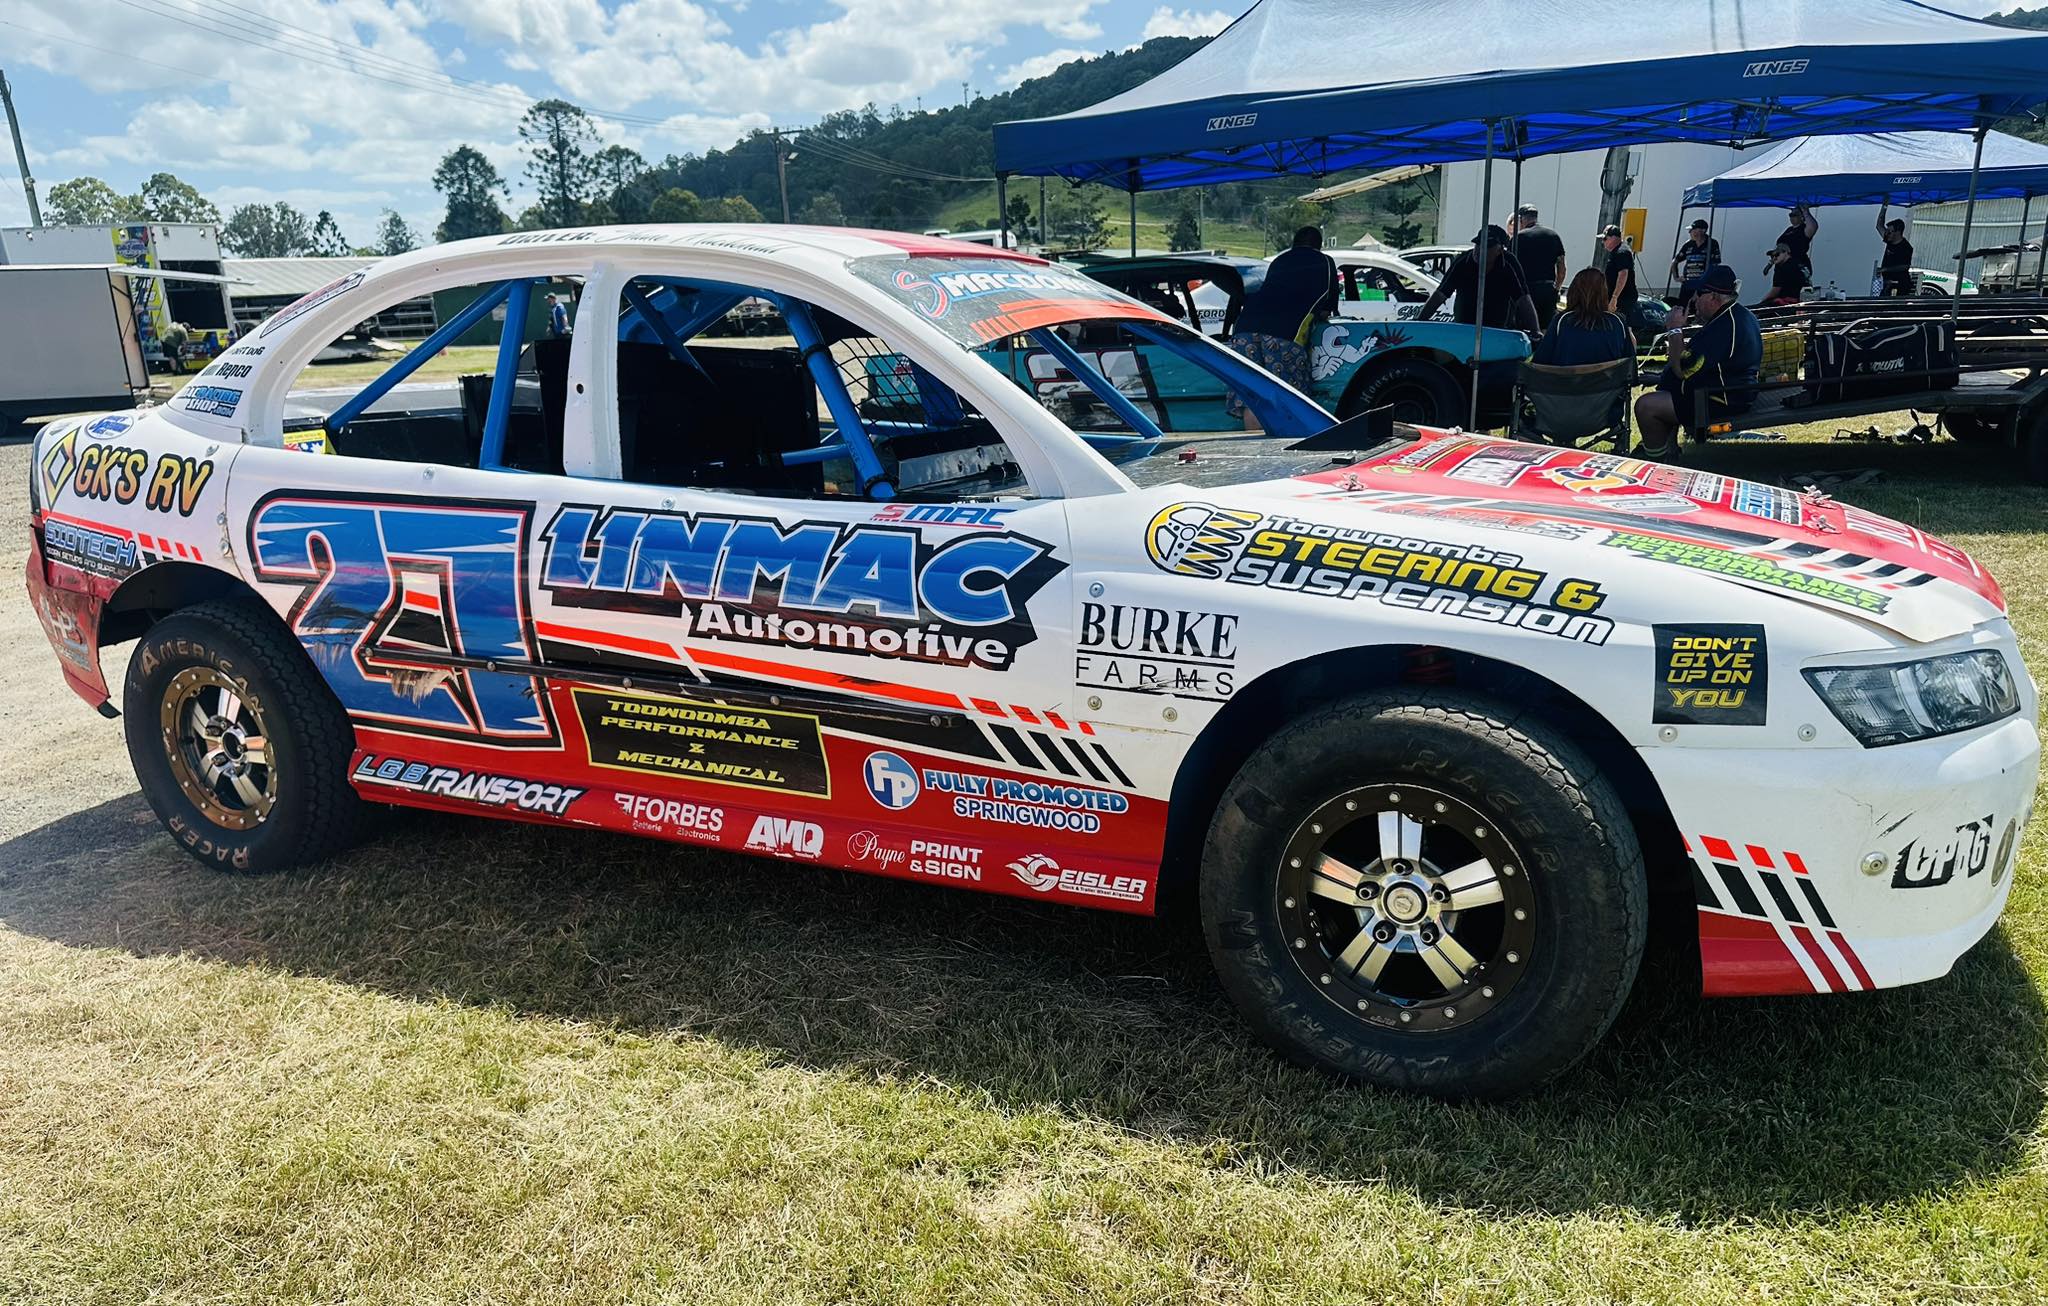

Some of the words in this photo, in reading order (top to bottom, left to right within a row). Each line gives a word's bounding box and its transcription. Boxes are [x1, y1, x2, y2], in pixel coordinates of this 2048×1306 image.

[1743, 59, 1810, 77] KINGS
[1206, 113, 1258, 132] KINGS
[215, 362, 253, 380] Repco
[74, 443, 148, 505] GK'S
[146, 453, 214, 517] RV
[872, 504, 1018, 528] SMAC
[542, 504, 1045, 627] LINMAC
[1249, 531, 1545, 599] STEERING
[1556, 577, 1607, 612] &
[1607, 538, 1891, 604] PERFORMANCE
[246, 488, 565, 751] 27
[1228, 558, 1616, 647] SUSPENSION
[697, 602, 1010, 664] Automotive
[1080, 601, 1241, 662] BURKE
[1672, 637, 1757, 651] DON'T
[1075, 657, 1235, 697] FARMS
[1667, 669, 1707, 684] UP
[1710, 670, 1753, 684] ON
[1669, 652, 1755, 669] GIVE
[607, 700, 771, 730] TOOWOOMBA
[1667, 688, 1747, 709] YOU
[601, 716, 800, 750] PERFORMANCE
[617, 751, 786, 783] MECHANICAL
[869, 757, 916, 807] FP
[425, 767, 582, 814] TRANSPORT
[922, 769, 990, 796] FULLY
[991, 777, 1129, 814] PROMOTED
[633, 798, 724, 832] FORBES
[953, 798, 1101, 834] SPRINGWOOD
[847, 830, 905, 870] Payne
[910, 840, 983, 864] PRINT
[910, 860, 981, 882] &SIGN
